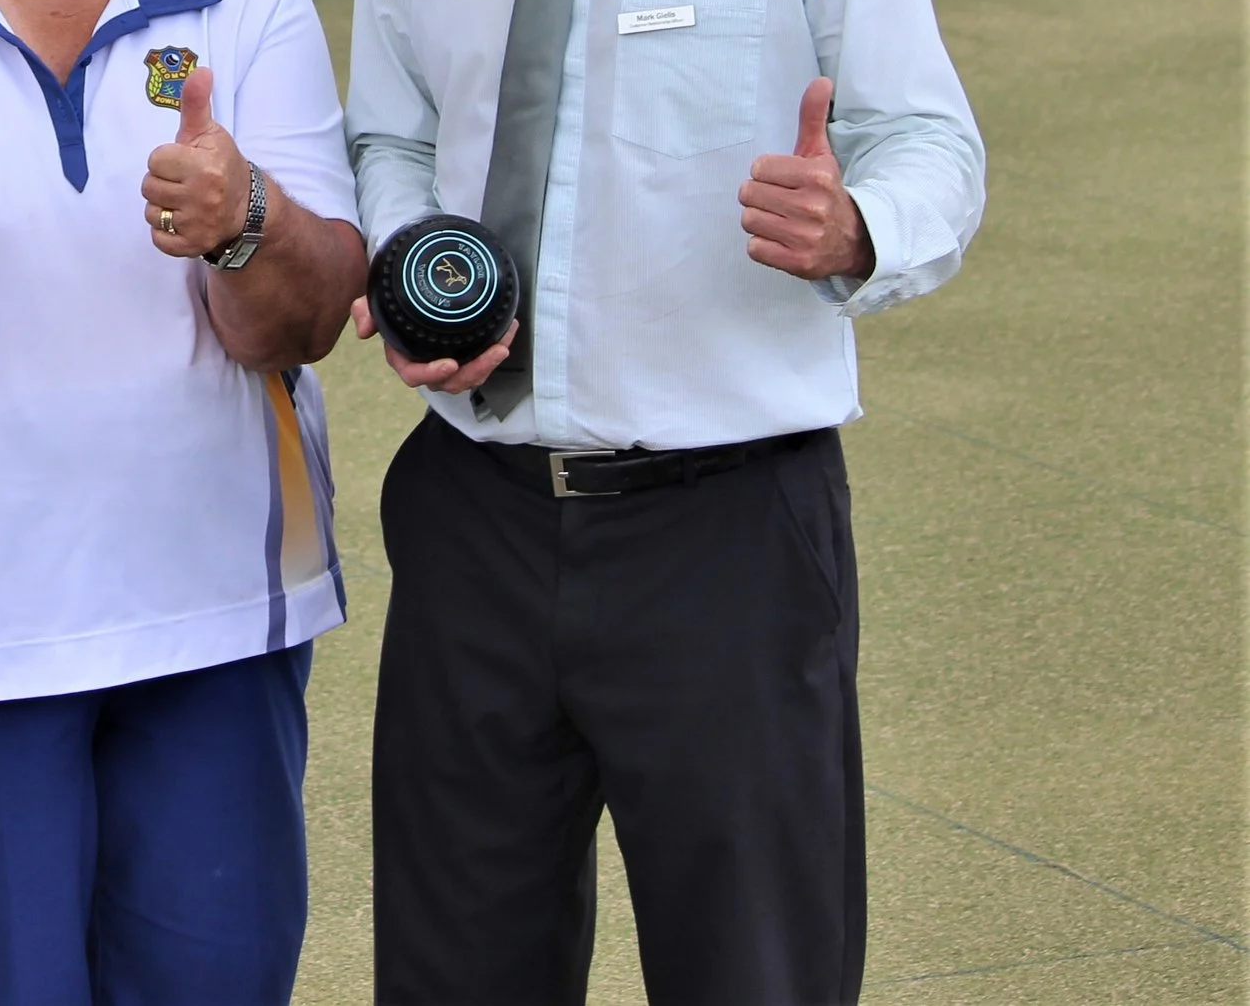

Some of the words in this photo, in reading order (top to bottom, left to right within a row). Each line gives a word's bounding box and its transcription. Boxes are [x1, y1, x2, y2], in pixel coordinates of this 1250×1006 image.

[636, 13, 654, 22] Mark
[155, 96, 180, 106] BOWLS
[458, 243, 484, 279] TAYLOR
